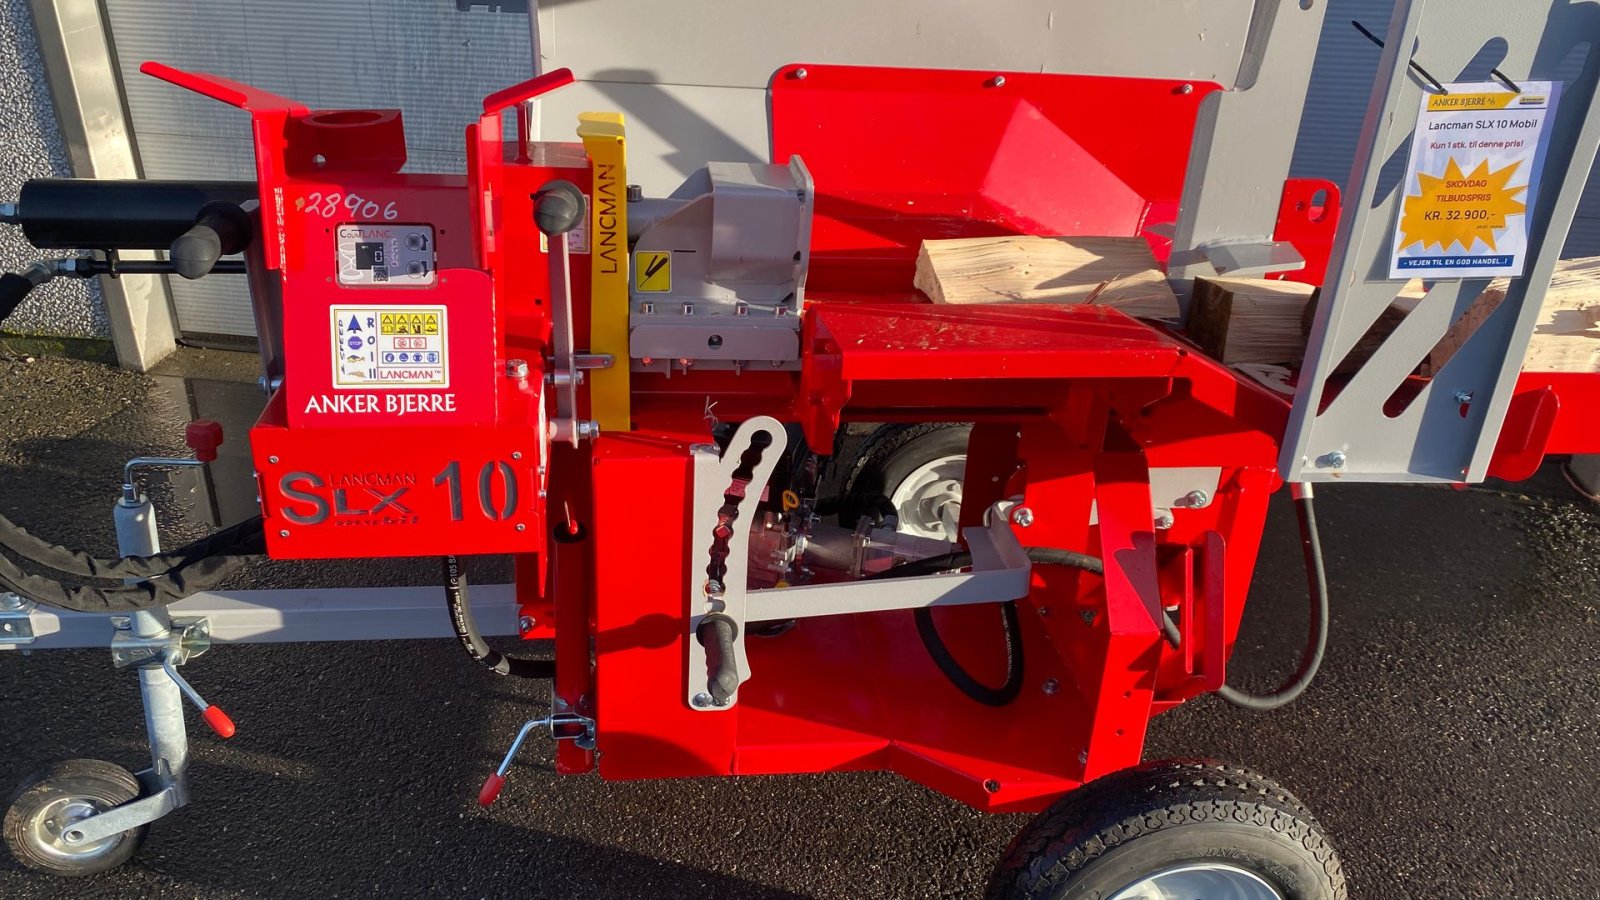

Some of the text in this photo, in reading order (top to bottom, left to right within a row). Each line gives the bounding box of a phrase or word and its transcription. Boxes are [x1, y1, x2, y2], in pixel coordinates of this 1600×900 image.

[1432, 97, 1458, 107] ANKER
[1460, 96, 1486, 107] BJERRE
[1429, 119, 1538, 131] Lancman SLX 10 Mobil
[1430, 141, 1446, 149] Kun
[1452, 141, 1466, 149] stk.
[1469, 140, 1477, 148] til
[1478, 140, 1504, 149] denne
[1504, 140, 1524, 150] pris!
[1445, 180, 1488, 188] SKOVDAG
[1436, 193, 1492, 203] TILBUDSPRIS
[304, 191, 398, 220] 28906
[598, 164, 617, 274] LANCMAN
[1424, 209, 1496, 221] KR. 32.900,-
[304, 393, 457, 416] ANKER BJERRE
[329, 472, 417, 487] LANCMAN
[279, 460, 518, 526] SLX 10
